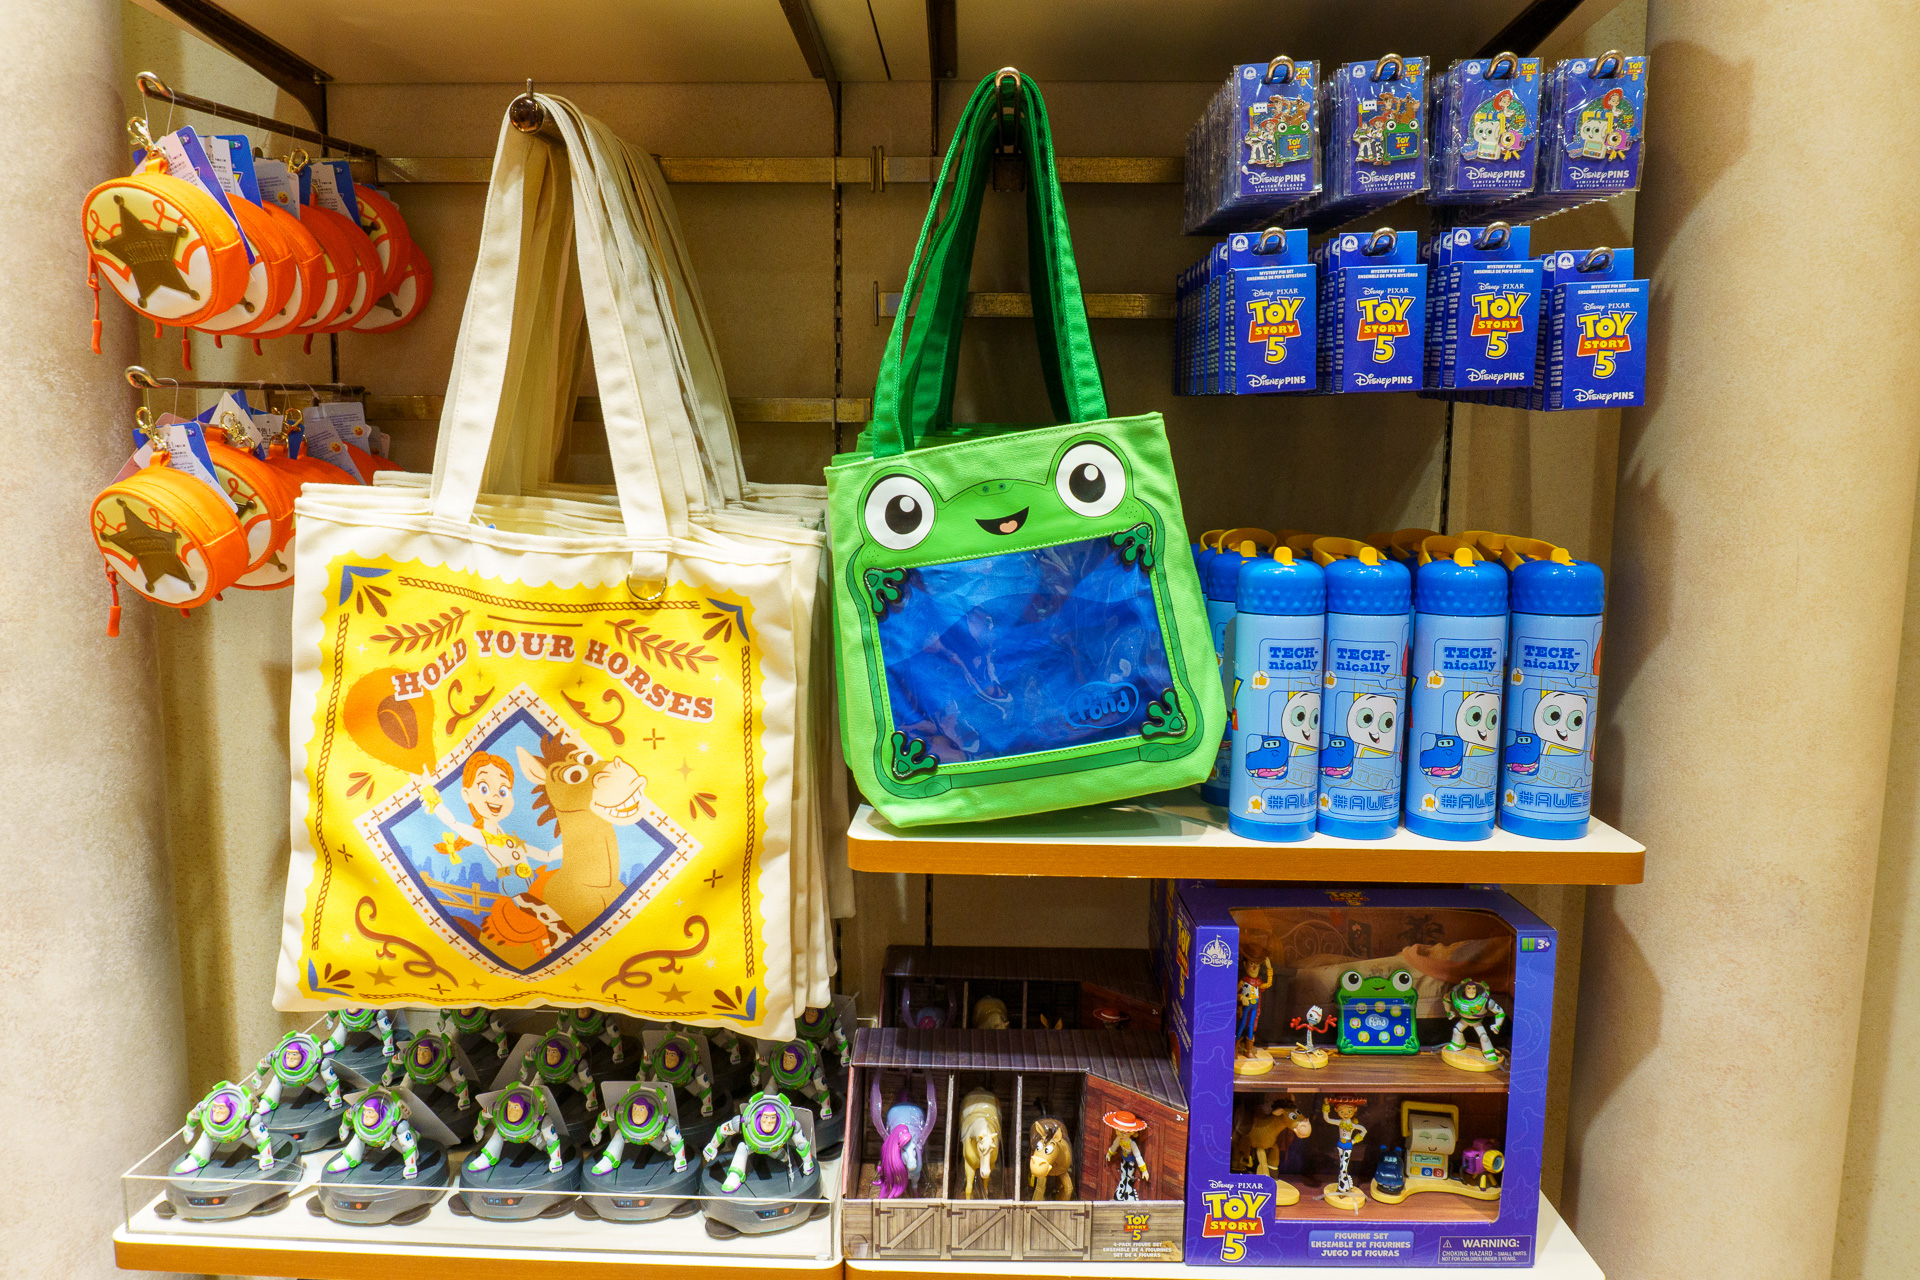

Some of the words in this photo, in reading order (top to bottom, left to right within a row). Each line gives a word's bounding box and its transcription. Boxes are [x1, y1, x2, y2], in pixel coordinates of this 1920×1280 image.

[1301, 78, 1306, 86] 5
[1410, 75, 1416, 83] 5
[1526, 74, 1532, 82] 5
[1632, 73, 1638, 81] 5
[1396, 136, 1410, 144] TOY
[1285, 174, 1306, 182] PINS
[1356, 171, 1394, 186] Disney
[1395, 172, 1416, 180] PINS
[1464, 166, 1503, 182] Disney
[1504, 170, 1525, 178] PINS
[1568, 167, 1607, 182] Disney
[1608, 170, 1629, 178] PINS
[1362, 287, 1384, 296] Disney
[1478, 282, 1499, 291] Disney
[1251, 289, 1273, 298] Disney
[1248, 298, 1302, 325] TOY
[1358, 297, 1413, 323] TOY
[1474, 293, 1528, 319] TOY
[1582, 302, 1605, 311] Disney
[1255, 325, 1295, 335] STORY
[1363, 324, 1405, 334] STORY
[1478, 320, 1519, 329] STORY
[1579, 312, 1634, 339] TOY
[1267, 336, 1285, 362] 5
[1374, 334, 1394, 361] 5
[1488, 330, 1508, 357] 5
[1583, 340, 1625, 349] STORY
[1595, 350, 1615, 377] 5
[1246, 374, 1285, 389] Disney
[1285, 376, 1306, 384] PINS
[1353, 373, 1391, 388] Disney
[1392, 376, 1413, 384] PINS
[1466, 368, 1504, 384] Disney
[1504, 372, 1525, 380] PINS
[1573, 388, 1612, 404] Disney
[1613, 392, 1634, 400] PINS
[1269, 646, 1319, 658] TECH-
[1337, 648, 1391, 661] TECH-
[1444, 646, 1497, 658] TECH-
[1524, 645, 1580, 658] TECH-
[1268, 660, 1318, 671] nically
[1336, 661, 1391, 674] nically
[1443, 660, 1497, 672] nically
[1524, 658, 1580, 672] nically
[392, 638, 467, 701] HOLD
[474, 629, 576, 663] YOUR
[583, 638, 714, 723] HORSES
[1078, 690, 1129, 720] Pond
[1537, 939, 1550, 949] 3+
[1199, 953, 1233, 968] Disney
[1208, 1180, 1234, 1190] Disney
[1204, 1193, 1267, 1220] TOY
[1125, 1215, 1150, 1225] TOY
[1210, 1221, 1258, 1230] STORY
[1132, 1230, 1141, 1240] 5
[1334, 1232, 1371, 1240] FIGURINE
[1373, 1232, 1389, 1240] SET
[1222, 1232, 1245, 1261] 5
[1369, 1241, 1411, 1249] FIGURINES
[1462, 1239, 1520, 1248] WARNING:
